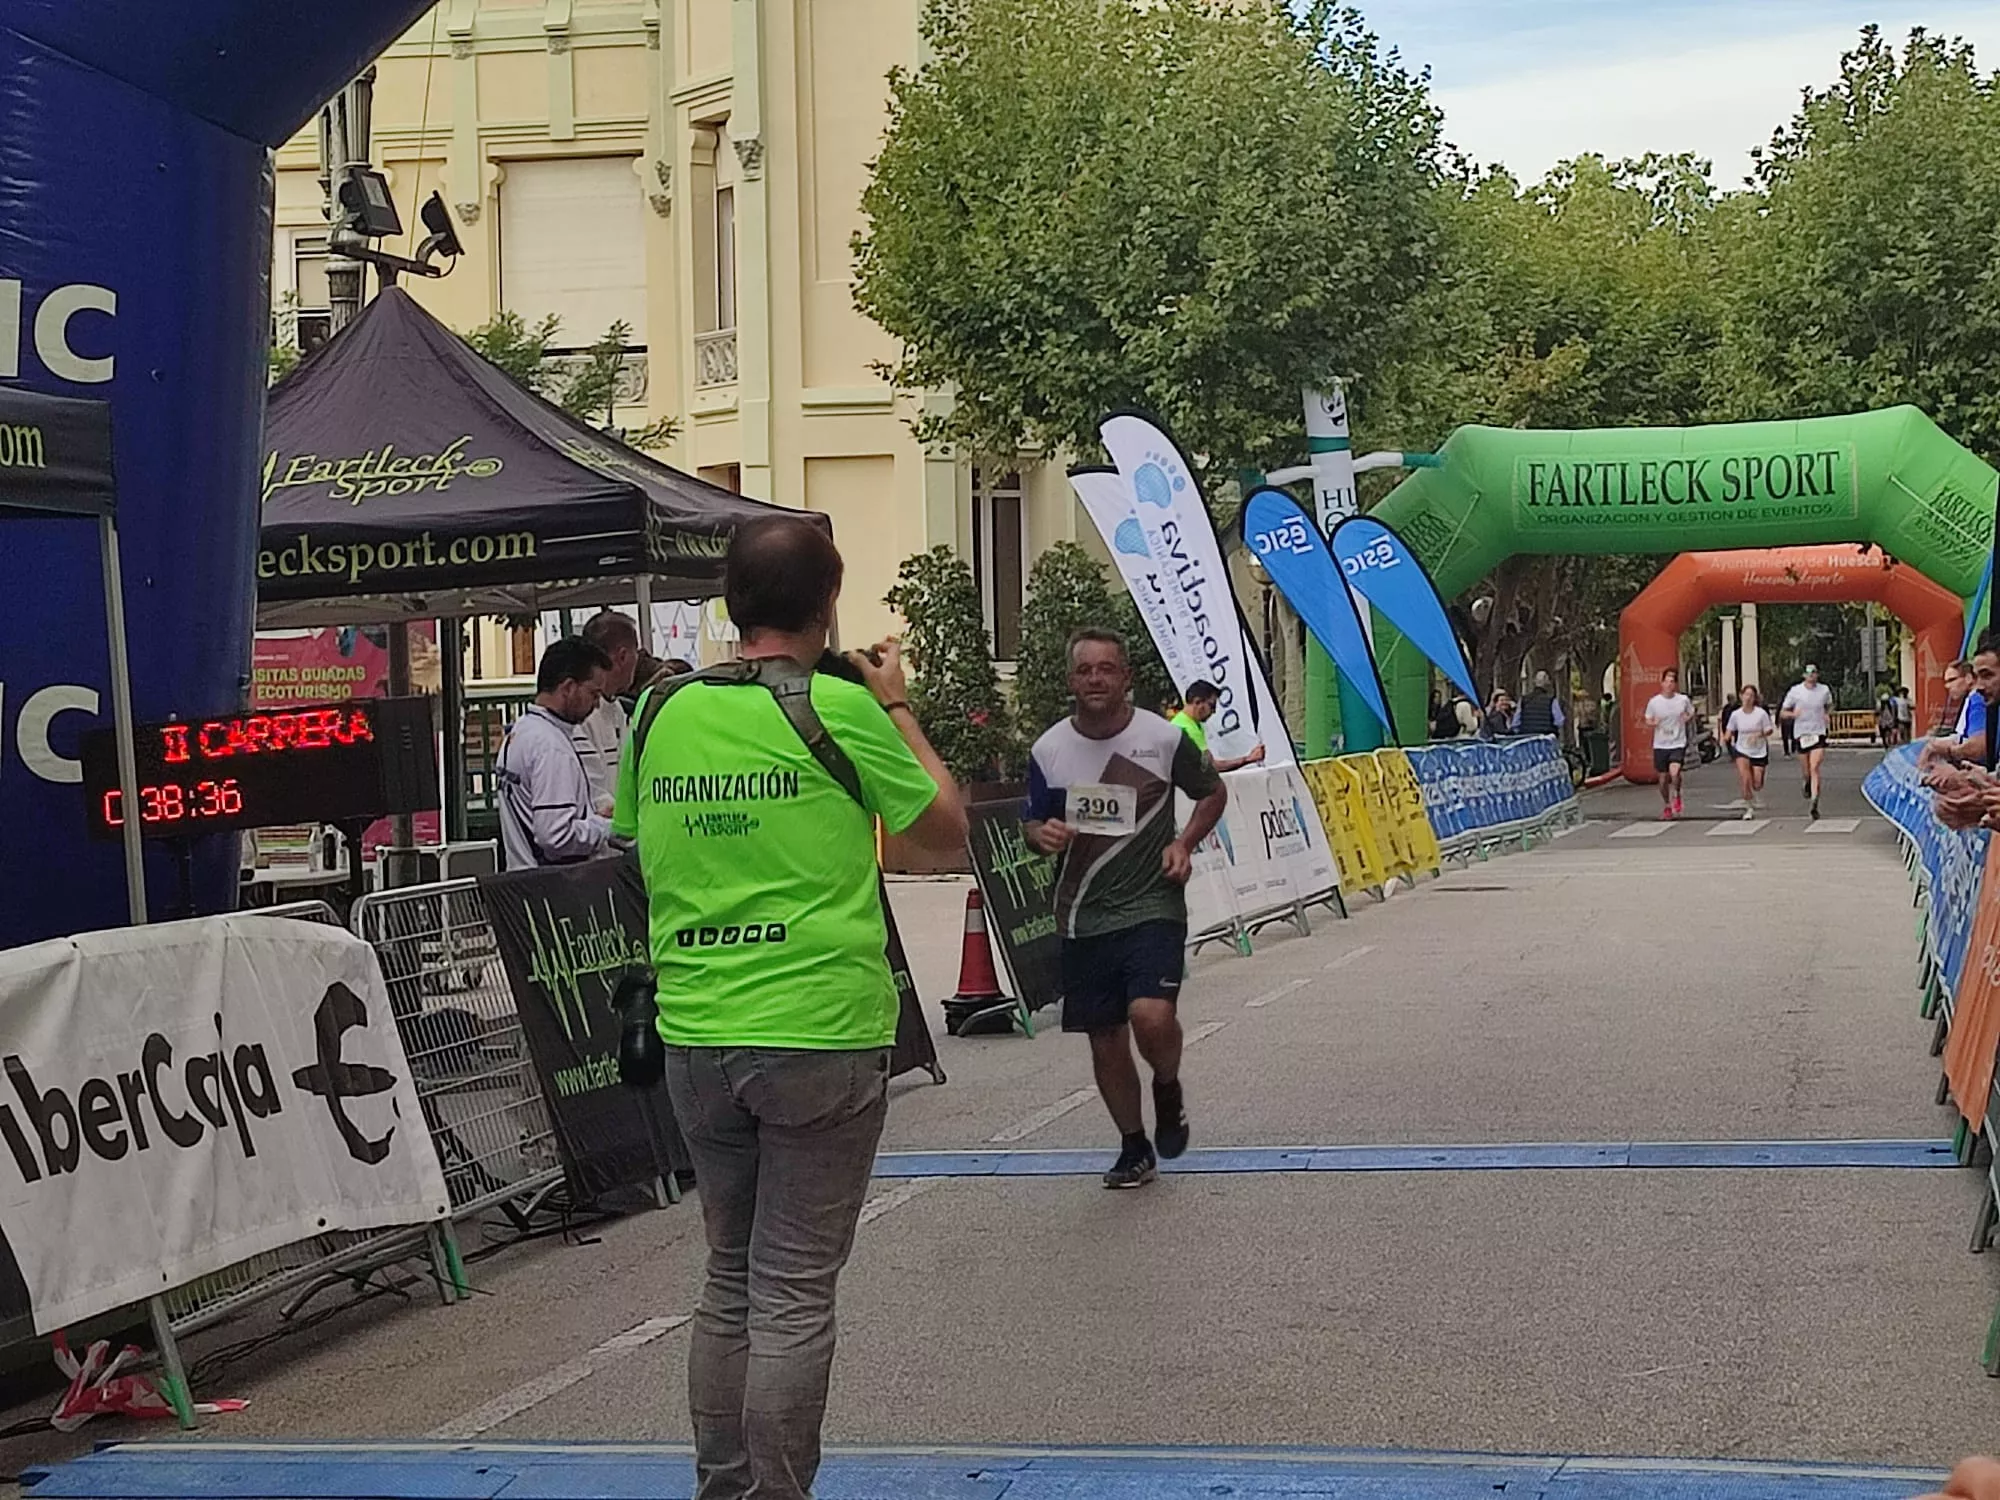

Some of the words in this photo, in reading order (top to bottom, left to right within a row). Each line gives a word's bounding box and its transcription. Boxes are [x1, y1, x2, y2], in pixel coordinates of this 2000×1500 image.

[1528, 458, 1713, 508] FARTLECK
[1722, 450, 1840, 503] SPORT
[1537, 511, 1649, 526] ORGANIZACION
[1654, 511, 1664, 523] Y
[1670, 508, 1733, 524] GESTION
[1738, 507, 1757, 521] DE
[1762, 503, 1833, 519] EVENTOS
[1711, 557, 1804, 572] Ayuntamiento
[1808, 555, 1825, 568] de
[1828, 554, 1880, 568] Huesca
[257, 684, 352, 700] ECOTURISMO
[199, 708, 374, 758] CARRERA
[652, 764, 799, 804] ORGANIZACIÓN
[1077, 796, 1120, 816] 390
